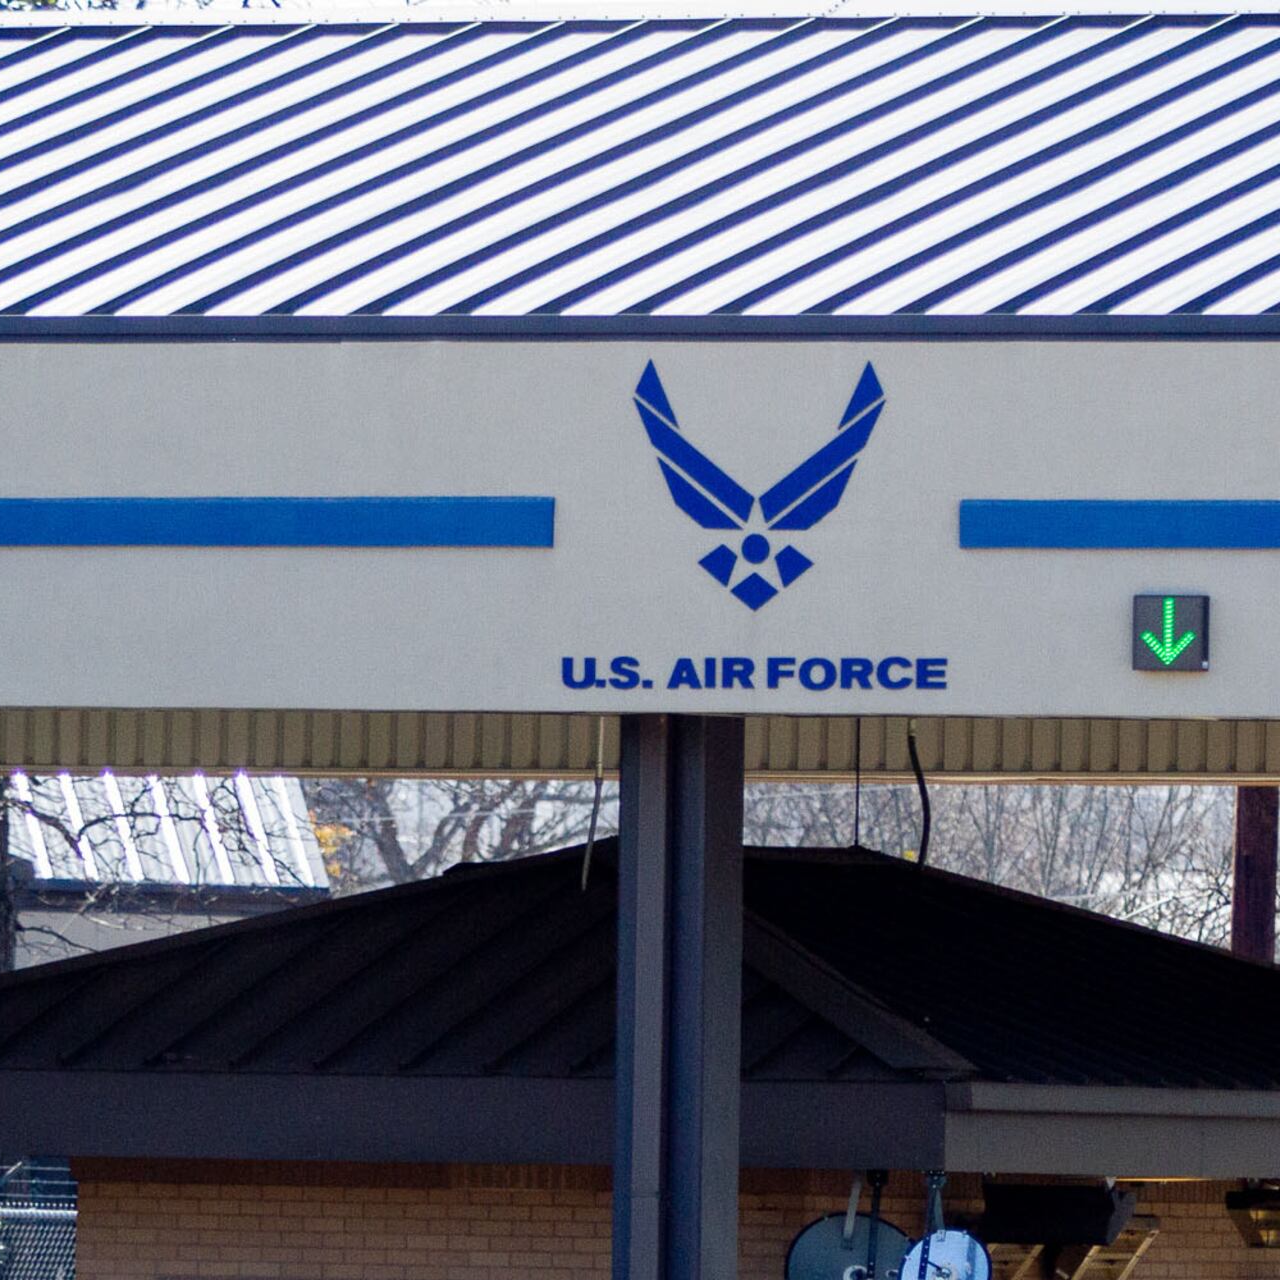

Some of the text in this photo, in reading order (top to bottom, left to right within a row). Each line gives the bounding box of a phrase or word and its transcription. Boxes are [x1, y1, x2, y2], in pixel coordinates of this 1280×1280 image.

[561, 655, 949, 691] U.S. AIR FORCE
